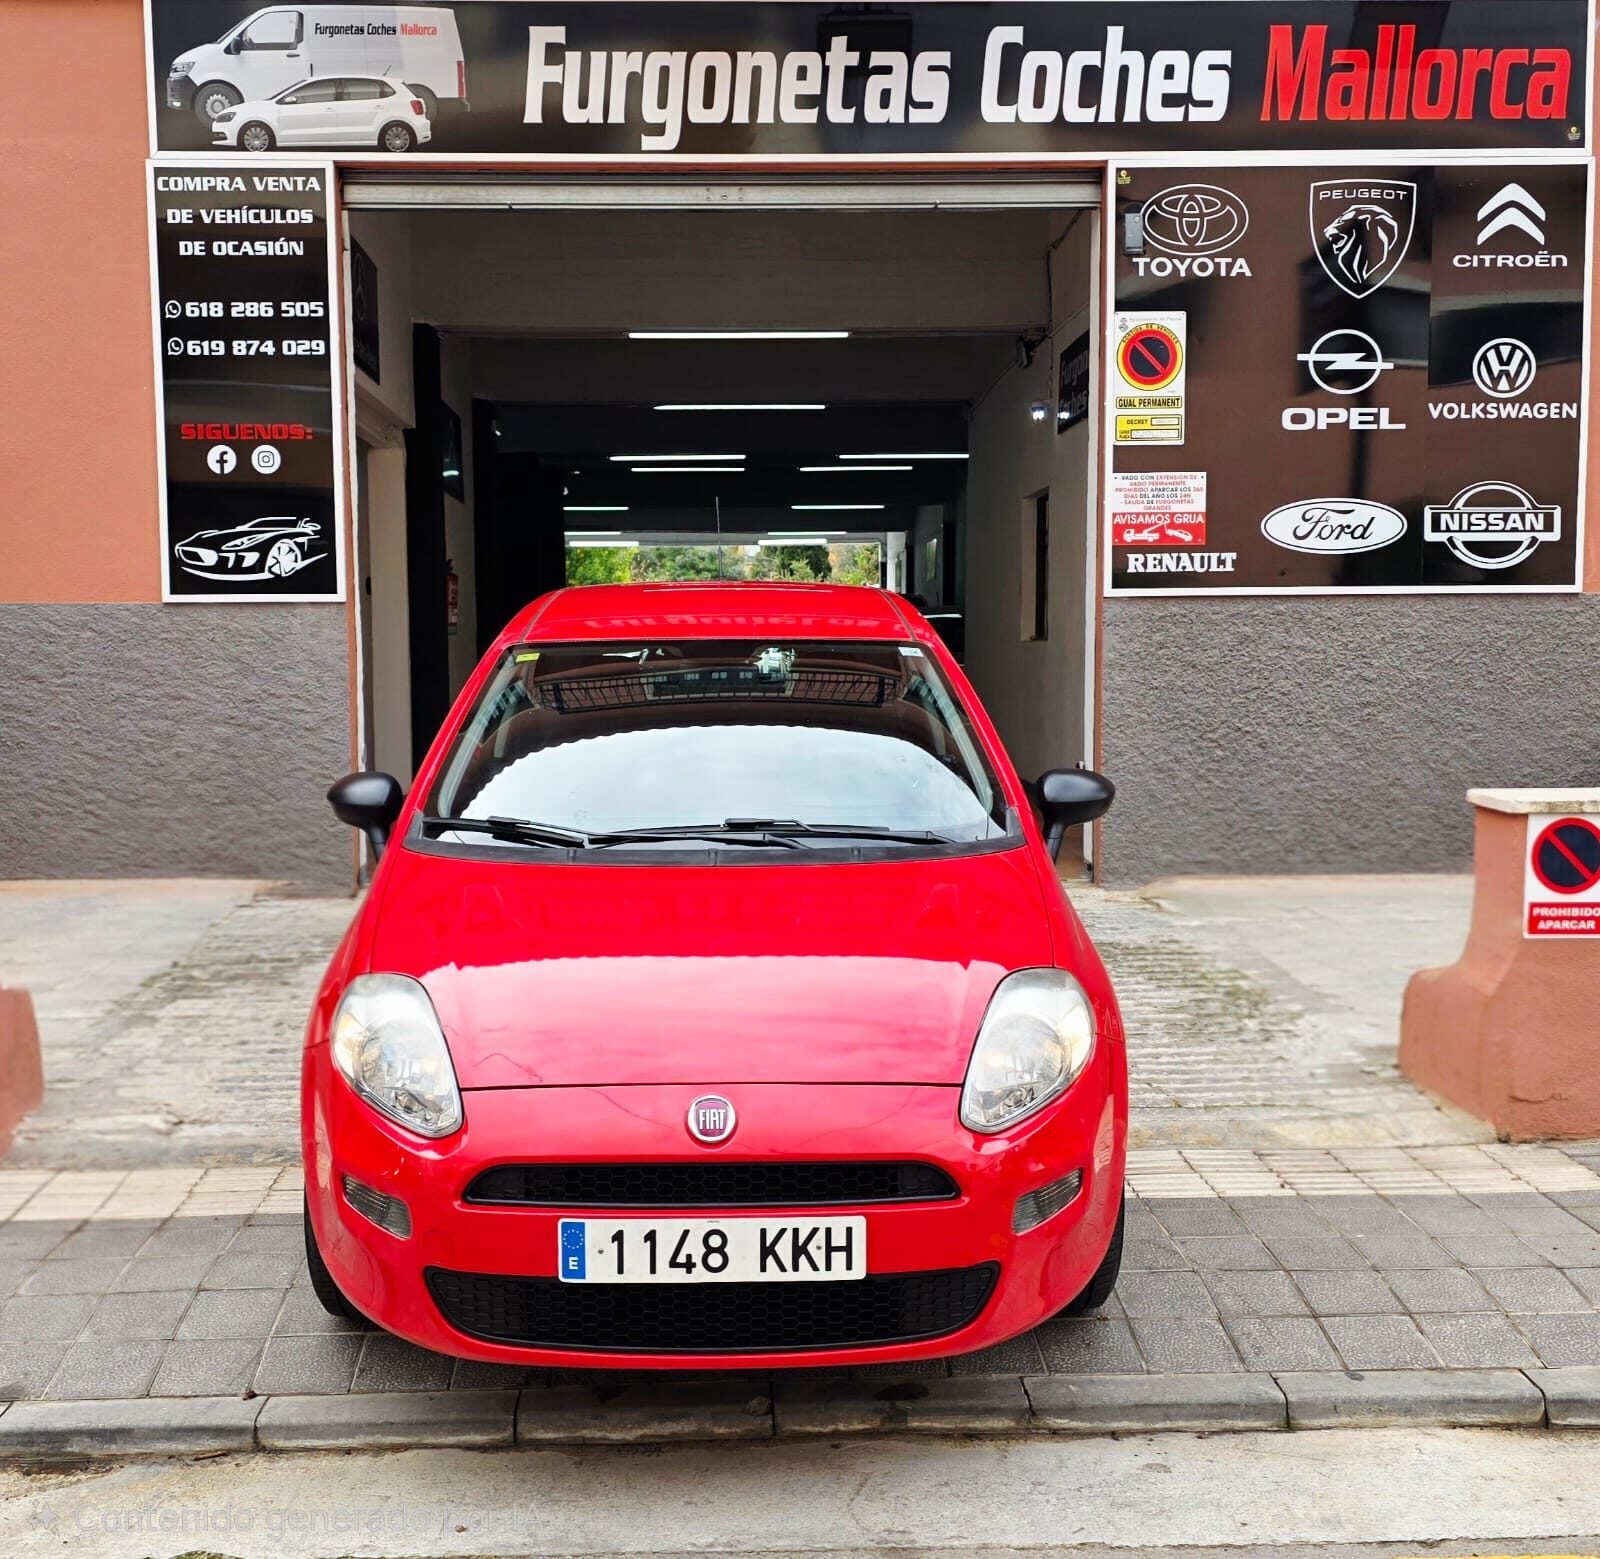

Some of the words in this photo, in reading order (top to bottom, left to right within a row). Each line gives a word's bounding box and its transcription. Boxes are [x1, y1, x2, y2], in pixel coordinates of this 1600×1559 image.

[315, 22, 365, 38] Furgonetas
[367, 22, 397, 36] Coches
[400, 23, 438, 36] Mallorca
[522, 25, 951, 151] Furgonetas
[980, 25, 1232, 123] Coches
[1260, 24, 1572, 121] Mallorca
[157, 176, 247, 192] COMPRA
[252, 176, 321, 192] VENTA
[1318, 188, 1408, 201] PEUGEOT
[166, 208, 194, 224] DE
[200, 205, 314, 224] VEHÍCULOS
[179, 240, 206, 256] DE
[212, 237, 304, 256] OCASIÓN
[1132, 257, 1252, 278] TOYOTA
[185, 301, 224, 318] 618
[230, 301, 274, 318] 286
[281, 301, 324, 318] 505
[186, 339, 225, 356] 619
[232, 339, 276, 356] 874
[282, 339, 325, 356] 029
[1118, 398, 1137, 408] GUAL
[1139, 397, 1180, 408] PERMANENT
[1428, 402, 1577, 419] VOLKSWAGEN
[1281, 407, 1407, 431] OPEL
[180, 423, 313, 440] SIGUENOS:
[1113, 513, 1171, 525] AVISAMOS
[1173, 513, 1205, 524] GRUA
[1293, 508, 1375, 540] Ford
[1440, 513, 1544, 531] NISSAN
[1126, 552, 1237, 573] RENAULT
[1532, 907, 1600, 917] PROHIBIDO
[1537, 920, 1595, 930] APARCAR
[699, 1109, 725, 1129] FIAT
[611, 1229, 729, 1274] 1148
[760, 1226, 852, 1272] KKH
